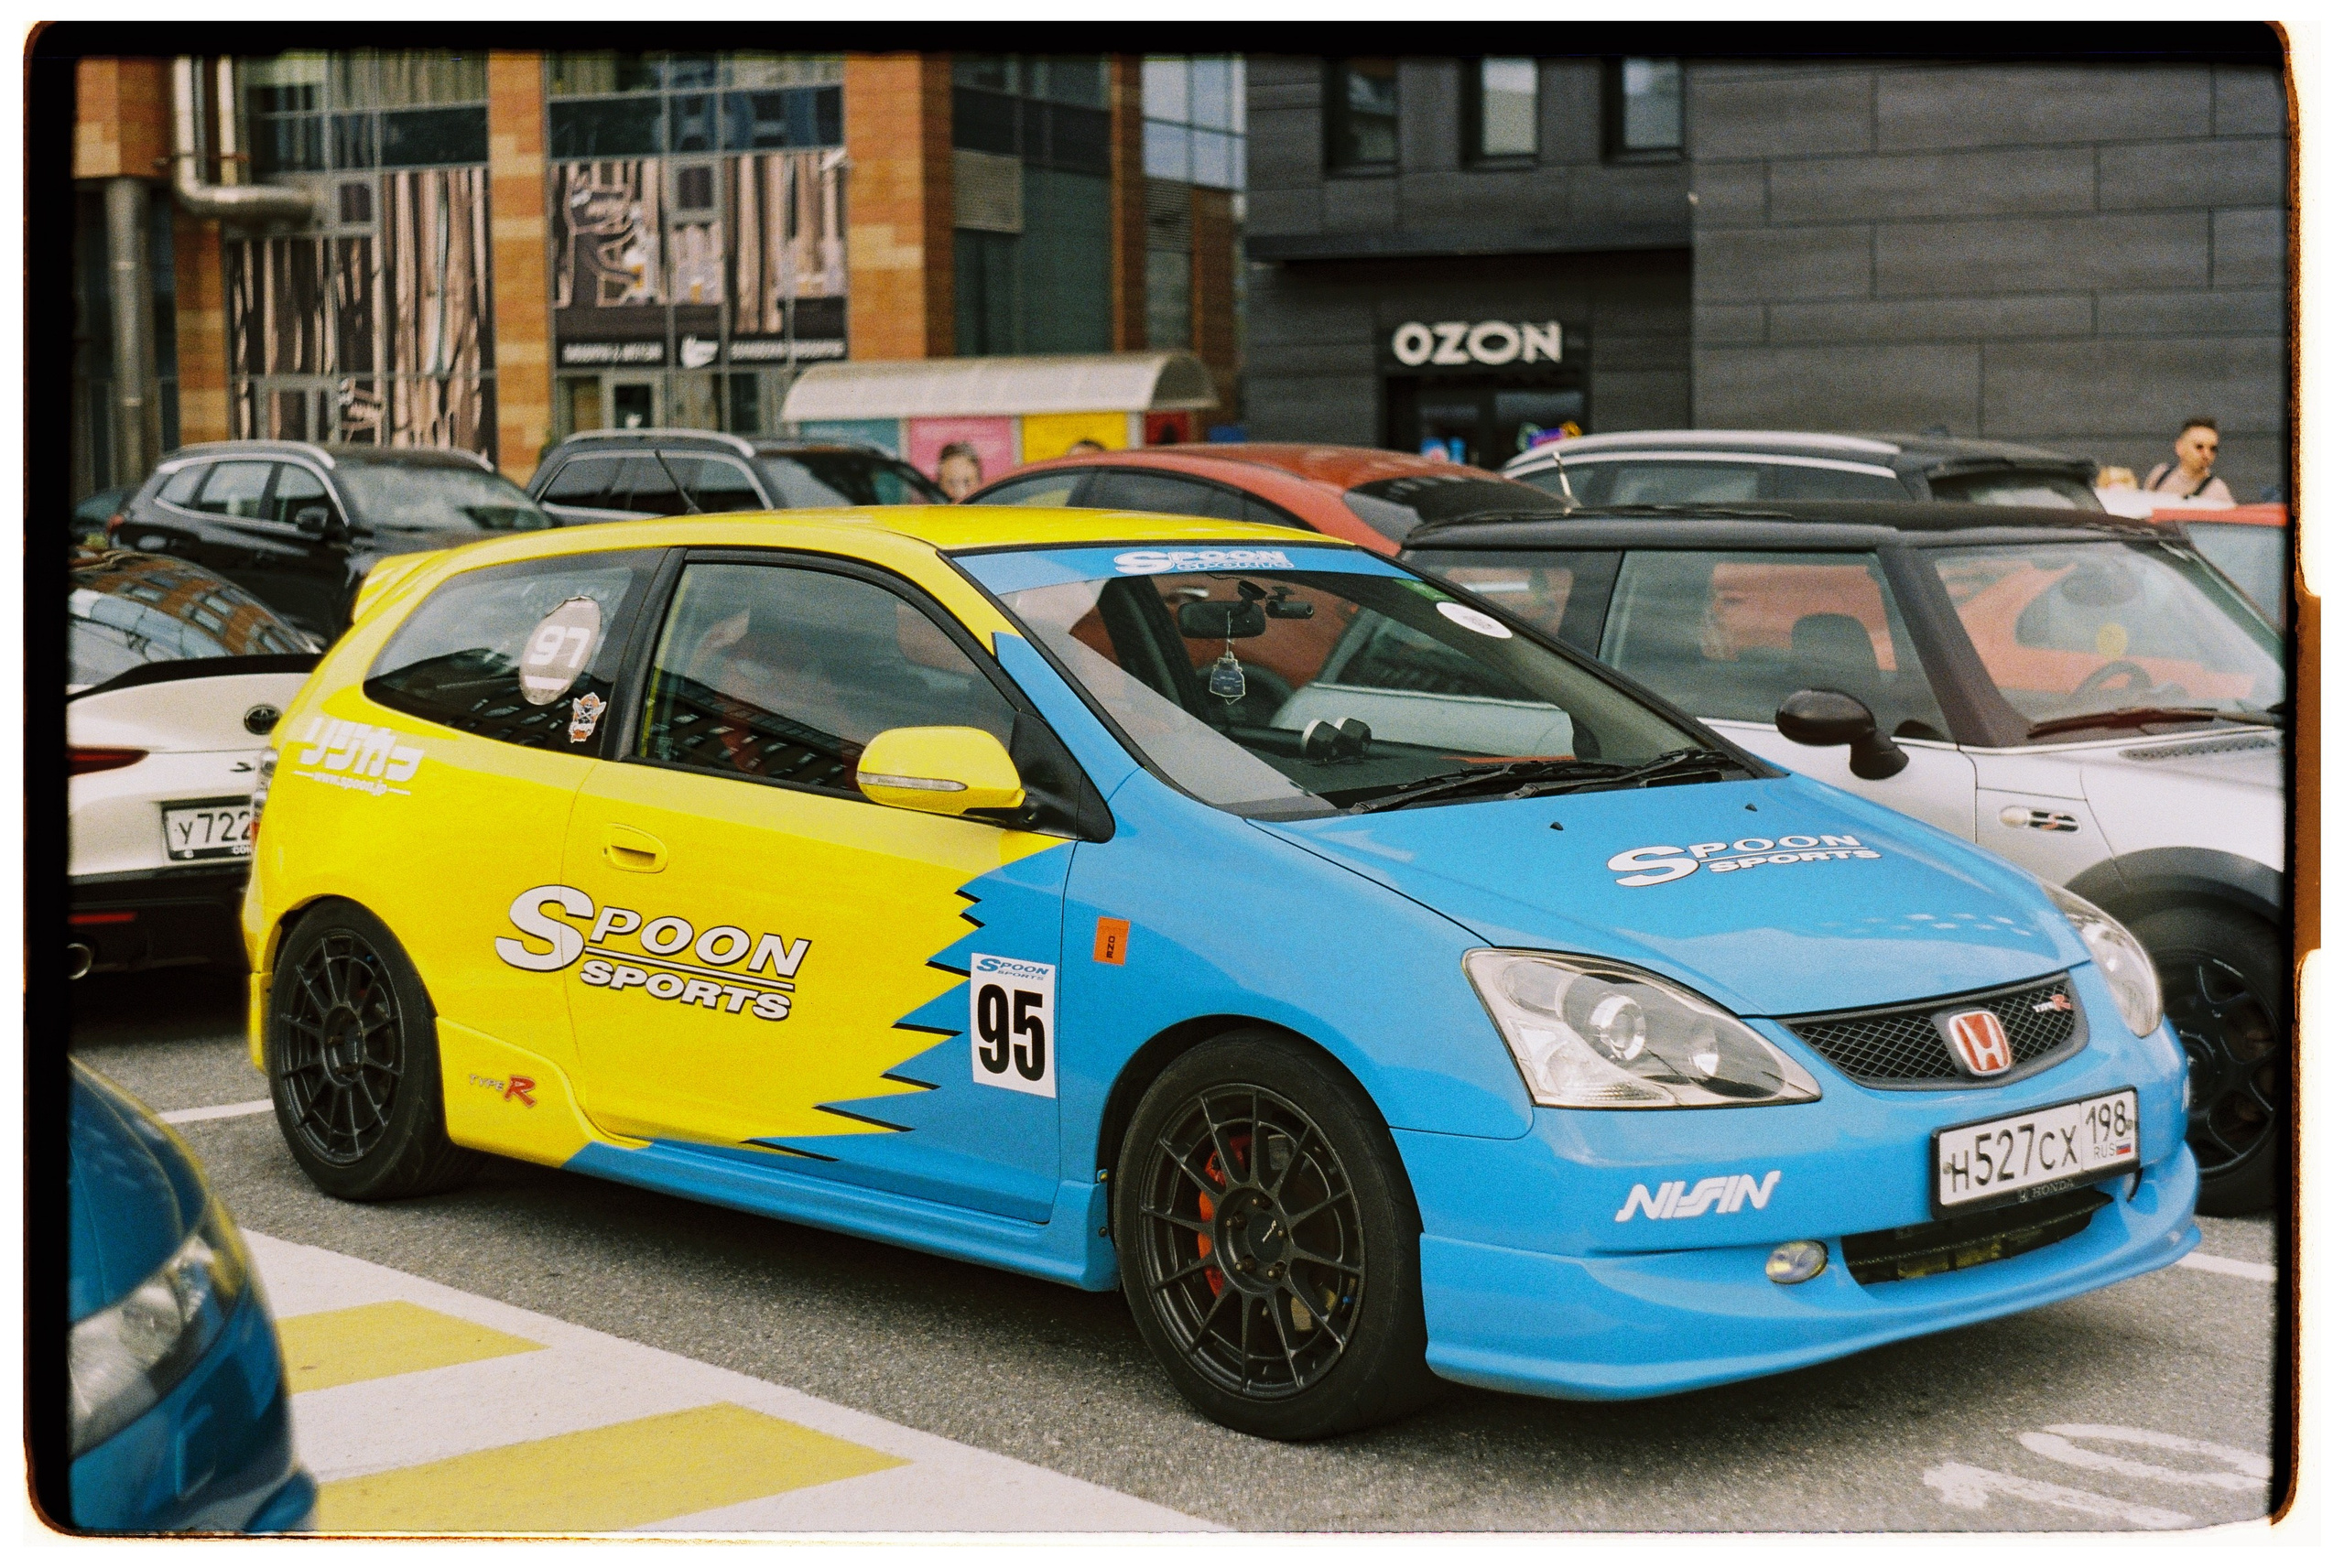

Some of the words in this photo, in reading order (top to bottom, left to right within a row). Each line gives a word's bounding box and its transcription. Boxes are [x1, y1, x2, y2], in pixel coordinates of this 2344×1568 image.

[1392, 320, 1563, 365] OZON
[1114, 551, 1287, 575] SPOON
[528, 626, 591, 669] 97
[1607, 835, 1861, 887] SPOON
[1709, 849, 1883, 873] SPORTS
[495, 884, 812, 979] SPOON
[1106, 935, 1116, 959] ONE
[976, 957, 1049, 976] SPOON
[997, 969, 1045, 981] SPORTS
[580, 958, 792, 1022] SPORTS
[978, 984, 1046, 1082] 95
[469, 1074, 505, 1092] TYPE
[503, 1074, 537, 1108] R
[2085, 1099, 2128, 1144] 198
[2093, 1144, 2116, 1161] RUS
[1614, 1170, 1782, 1223] NISSIN
[2032, 1179, 2074, 1196] HONDA
